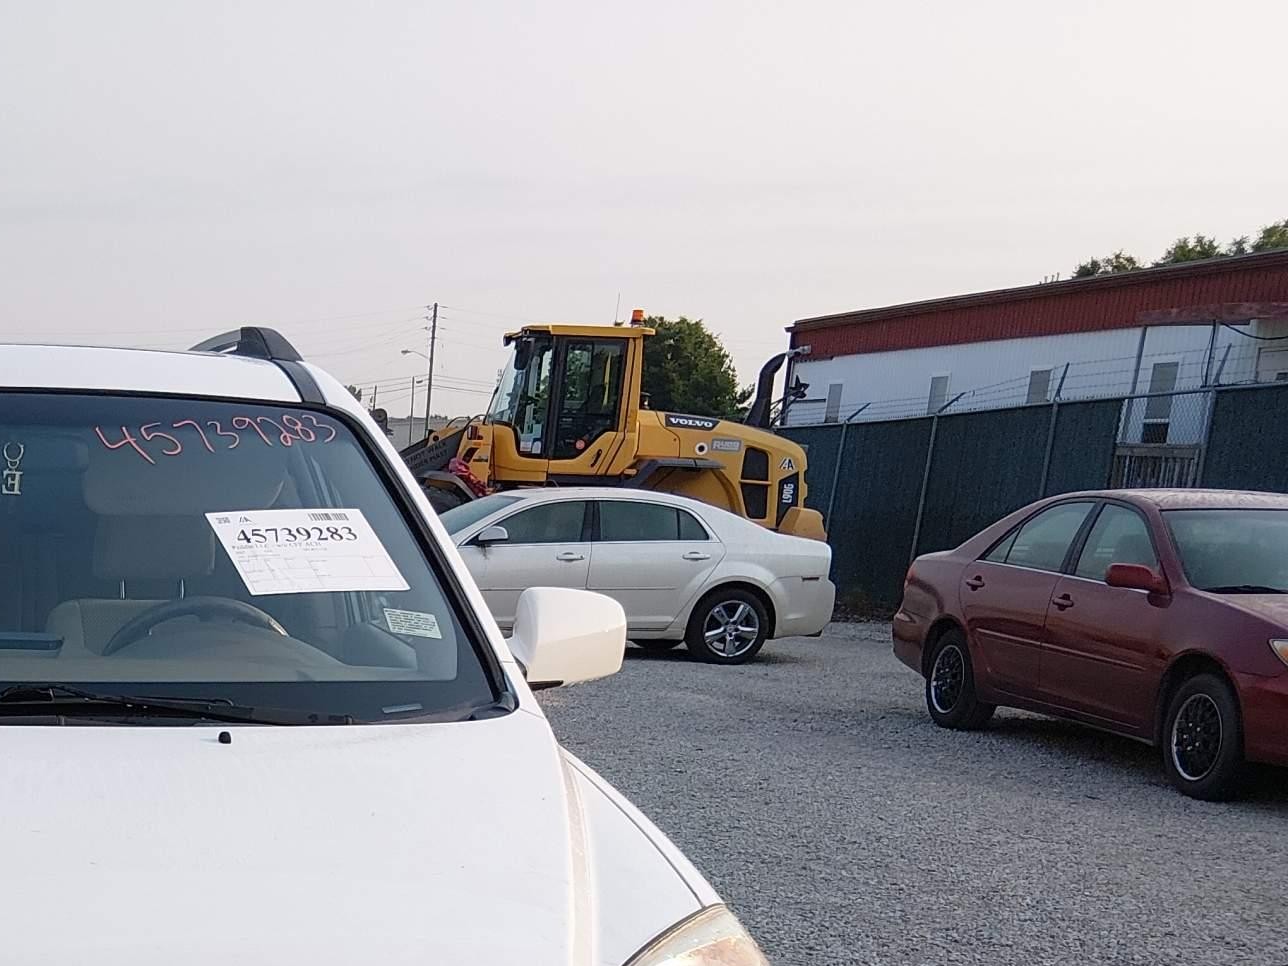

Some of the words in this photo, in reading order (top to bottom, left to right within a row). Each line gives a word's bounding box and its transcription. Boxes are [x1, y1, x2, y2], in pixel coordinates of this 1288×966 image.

[669, 417, 713, 428] VOLVO
[95, 414, 336, 465] 45739283
[782, 483, 794, 503] L90G
[237, 526, 358, 543] 45739283
